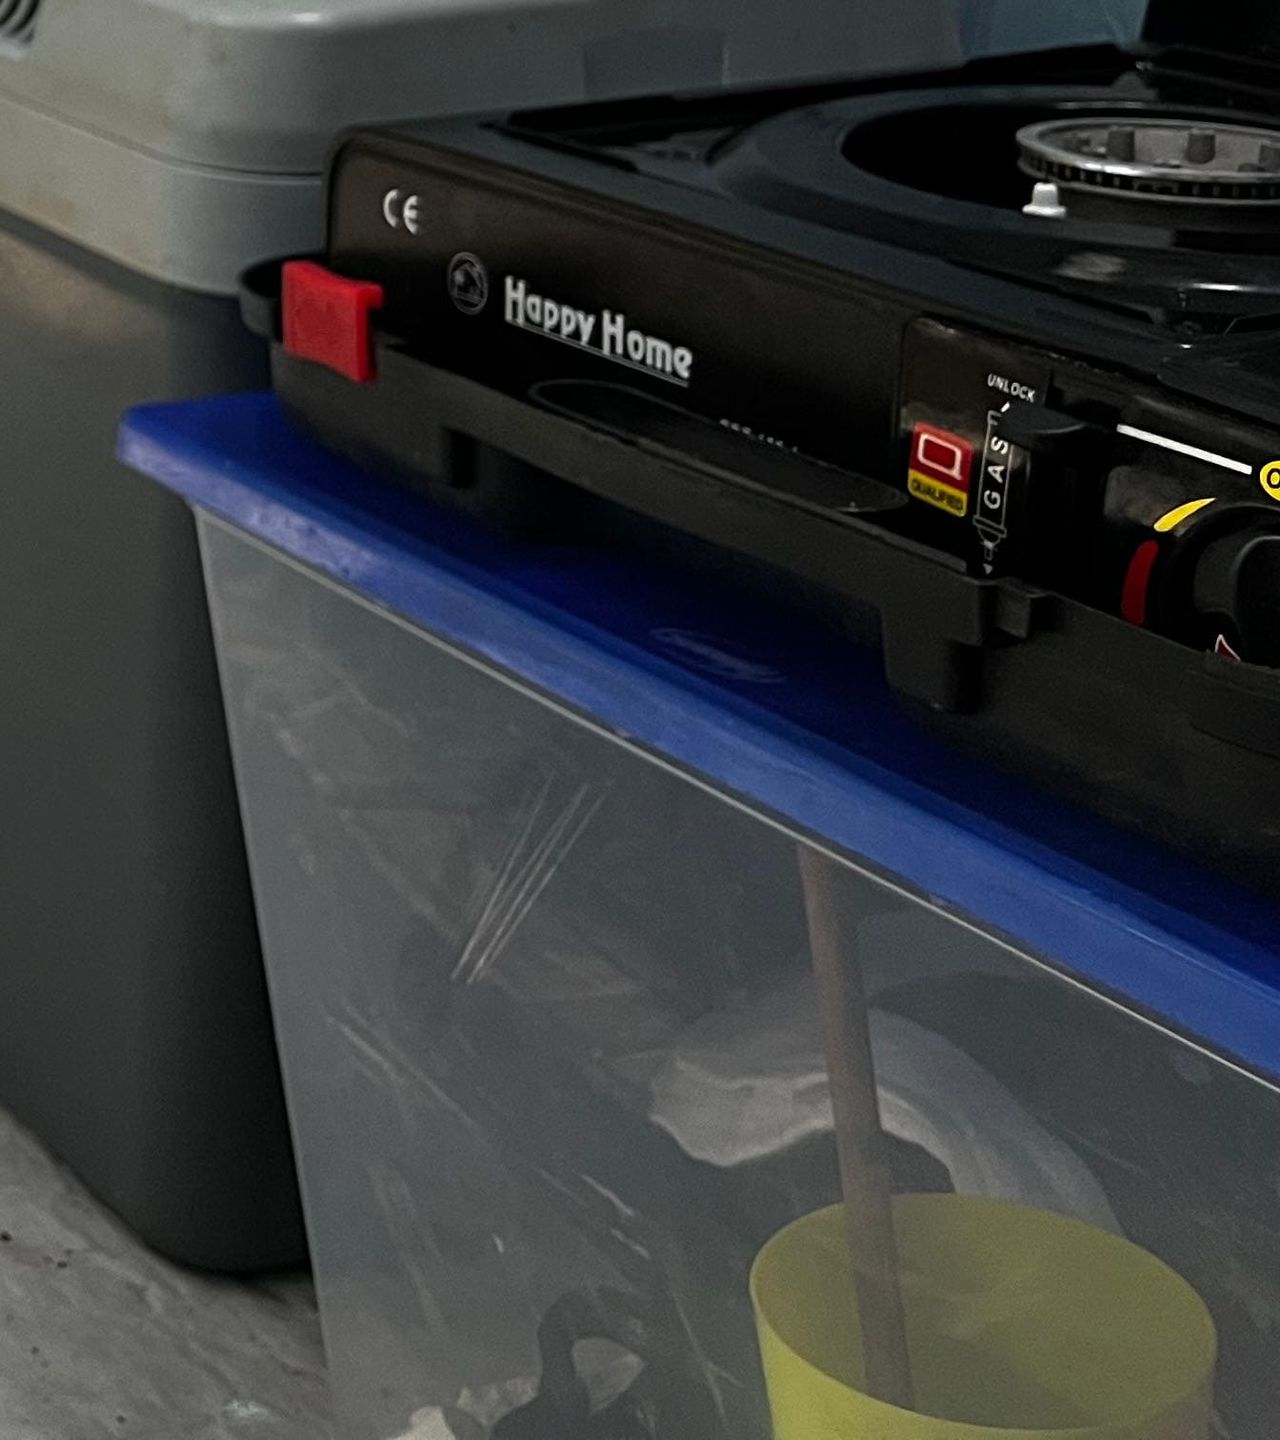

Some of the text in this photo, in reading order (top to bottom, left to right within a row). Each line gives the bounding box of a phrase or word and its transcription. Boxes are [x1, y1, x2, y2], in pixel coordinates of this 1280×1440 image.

[383, 189, 418, 235] CE
[504, 275, 692, 379] Happy Home
[987, 373, 1035, 402] UNLOCK
[983, 436, 1008, 509] GAS
